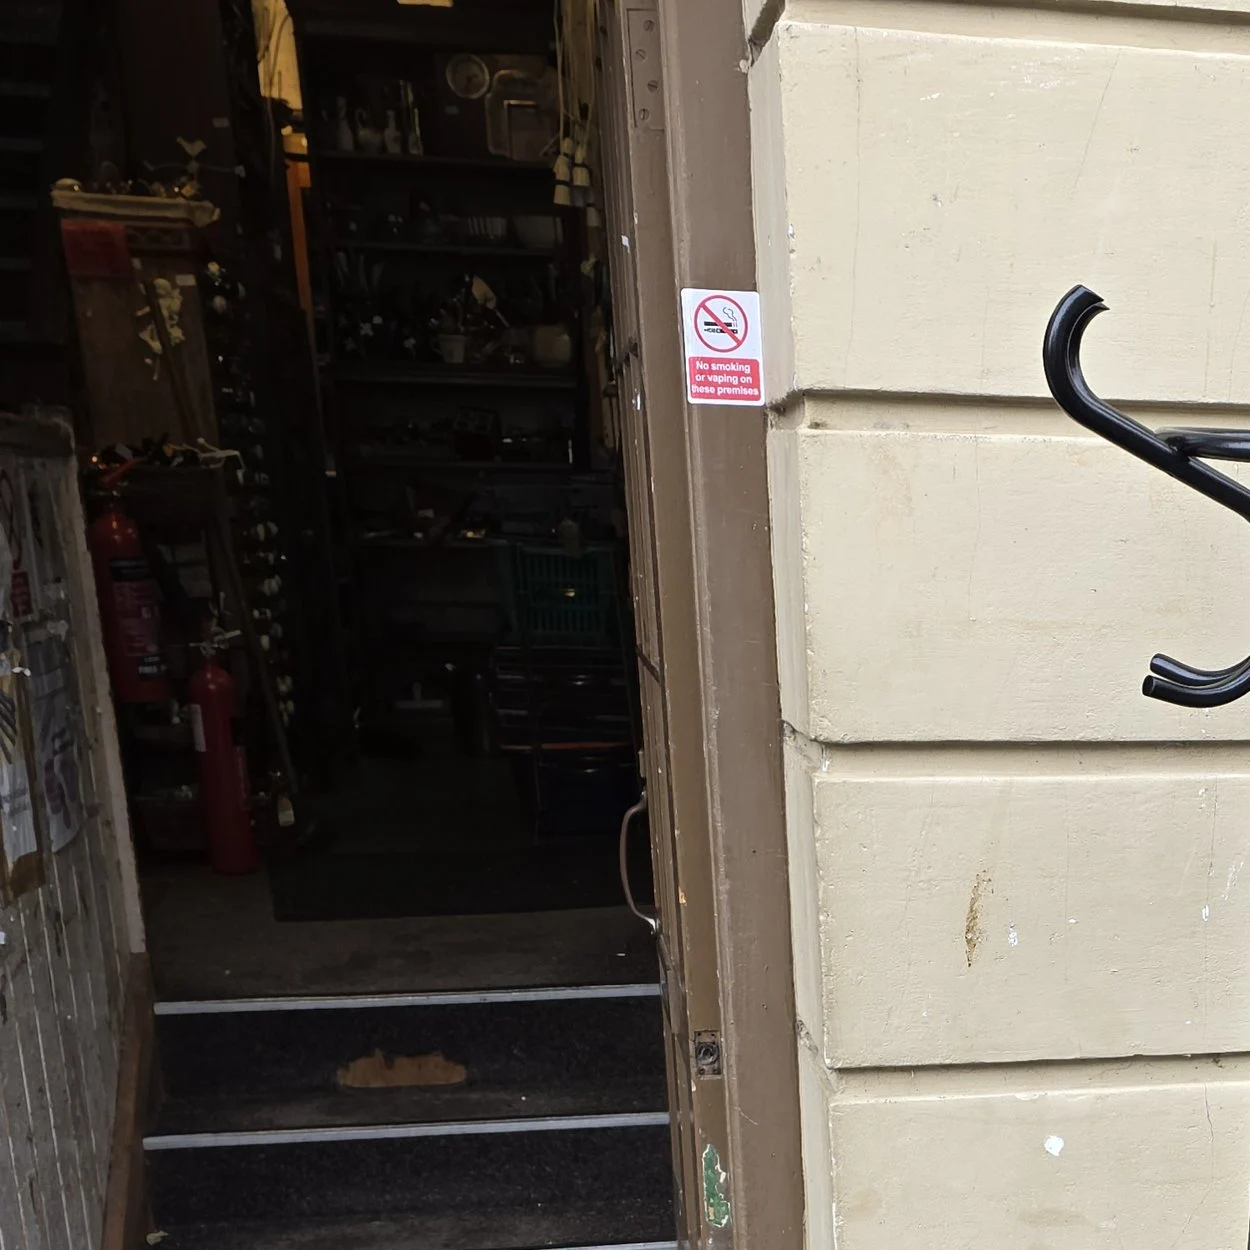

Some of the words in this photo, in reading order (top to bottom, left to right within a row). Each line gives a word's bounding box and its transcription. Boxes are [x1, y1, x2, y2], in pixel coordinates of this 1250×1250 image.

[696, 360, 709, 371] No
[711, 362, 751, 374] smoking
[695, 374, 705, 382] or
[706, 374, 739, 385] vaping
[740, 376, 752, 384] on
[691, 384, 715, 394] these
[717, 386, 759, 396] premises
